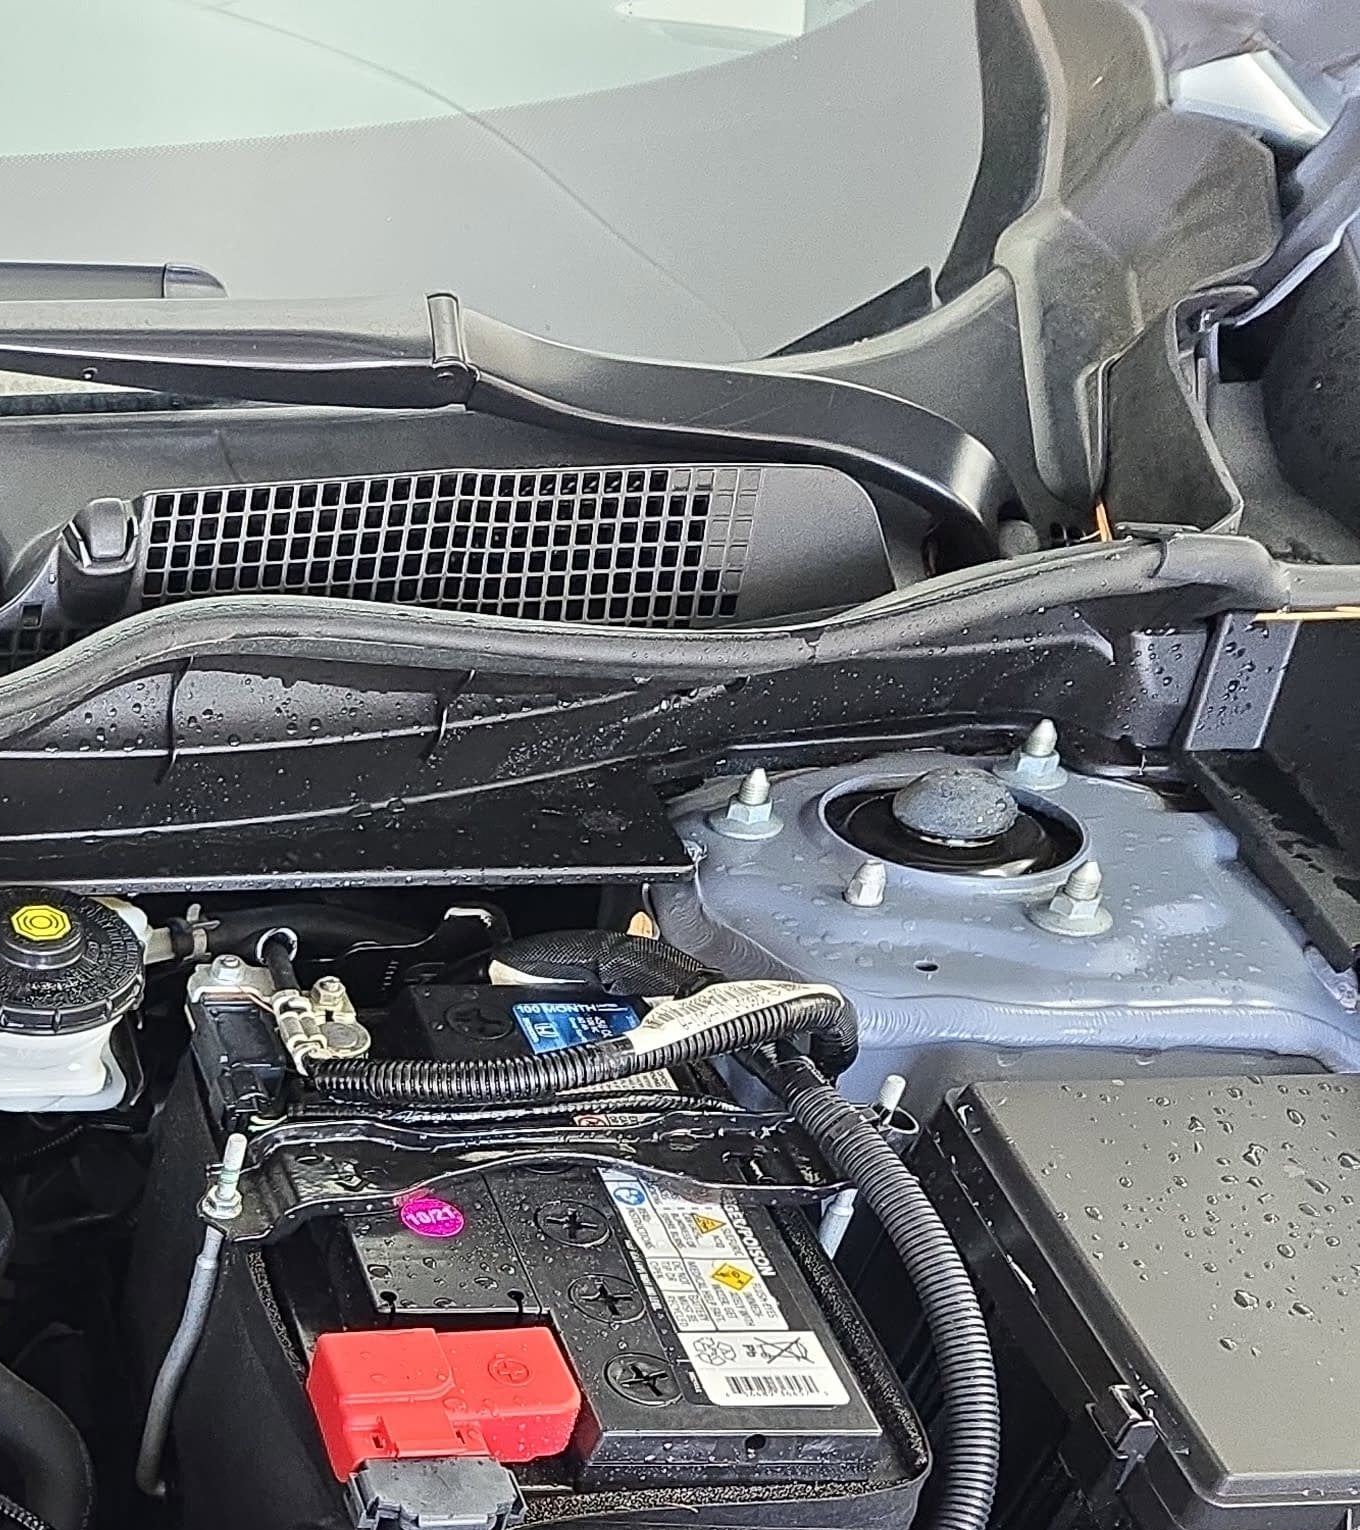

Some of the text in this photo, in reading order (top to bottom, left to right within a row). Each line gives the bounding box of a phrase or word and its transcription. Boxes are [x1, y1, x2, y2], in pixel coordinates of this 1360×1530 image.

[516, 1005, 540, 1014] 100
[543, 1004, 597, 1013] MONTH
[406, 1206, 456, 1226] 10/21
[741, 1343, 760, 1357] Pb
